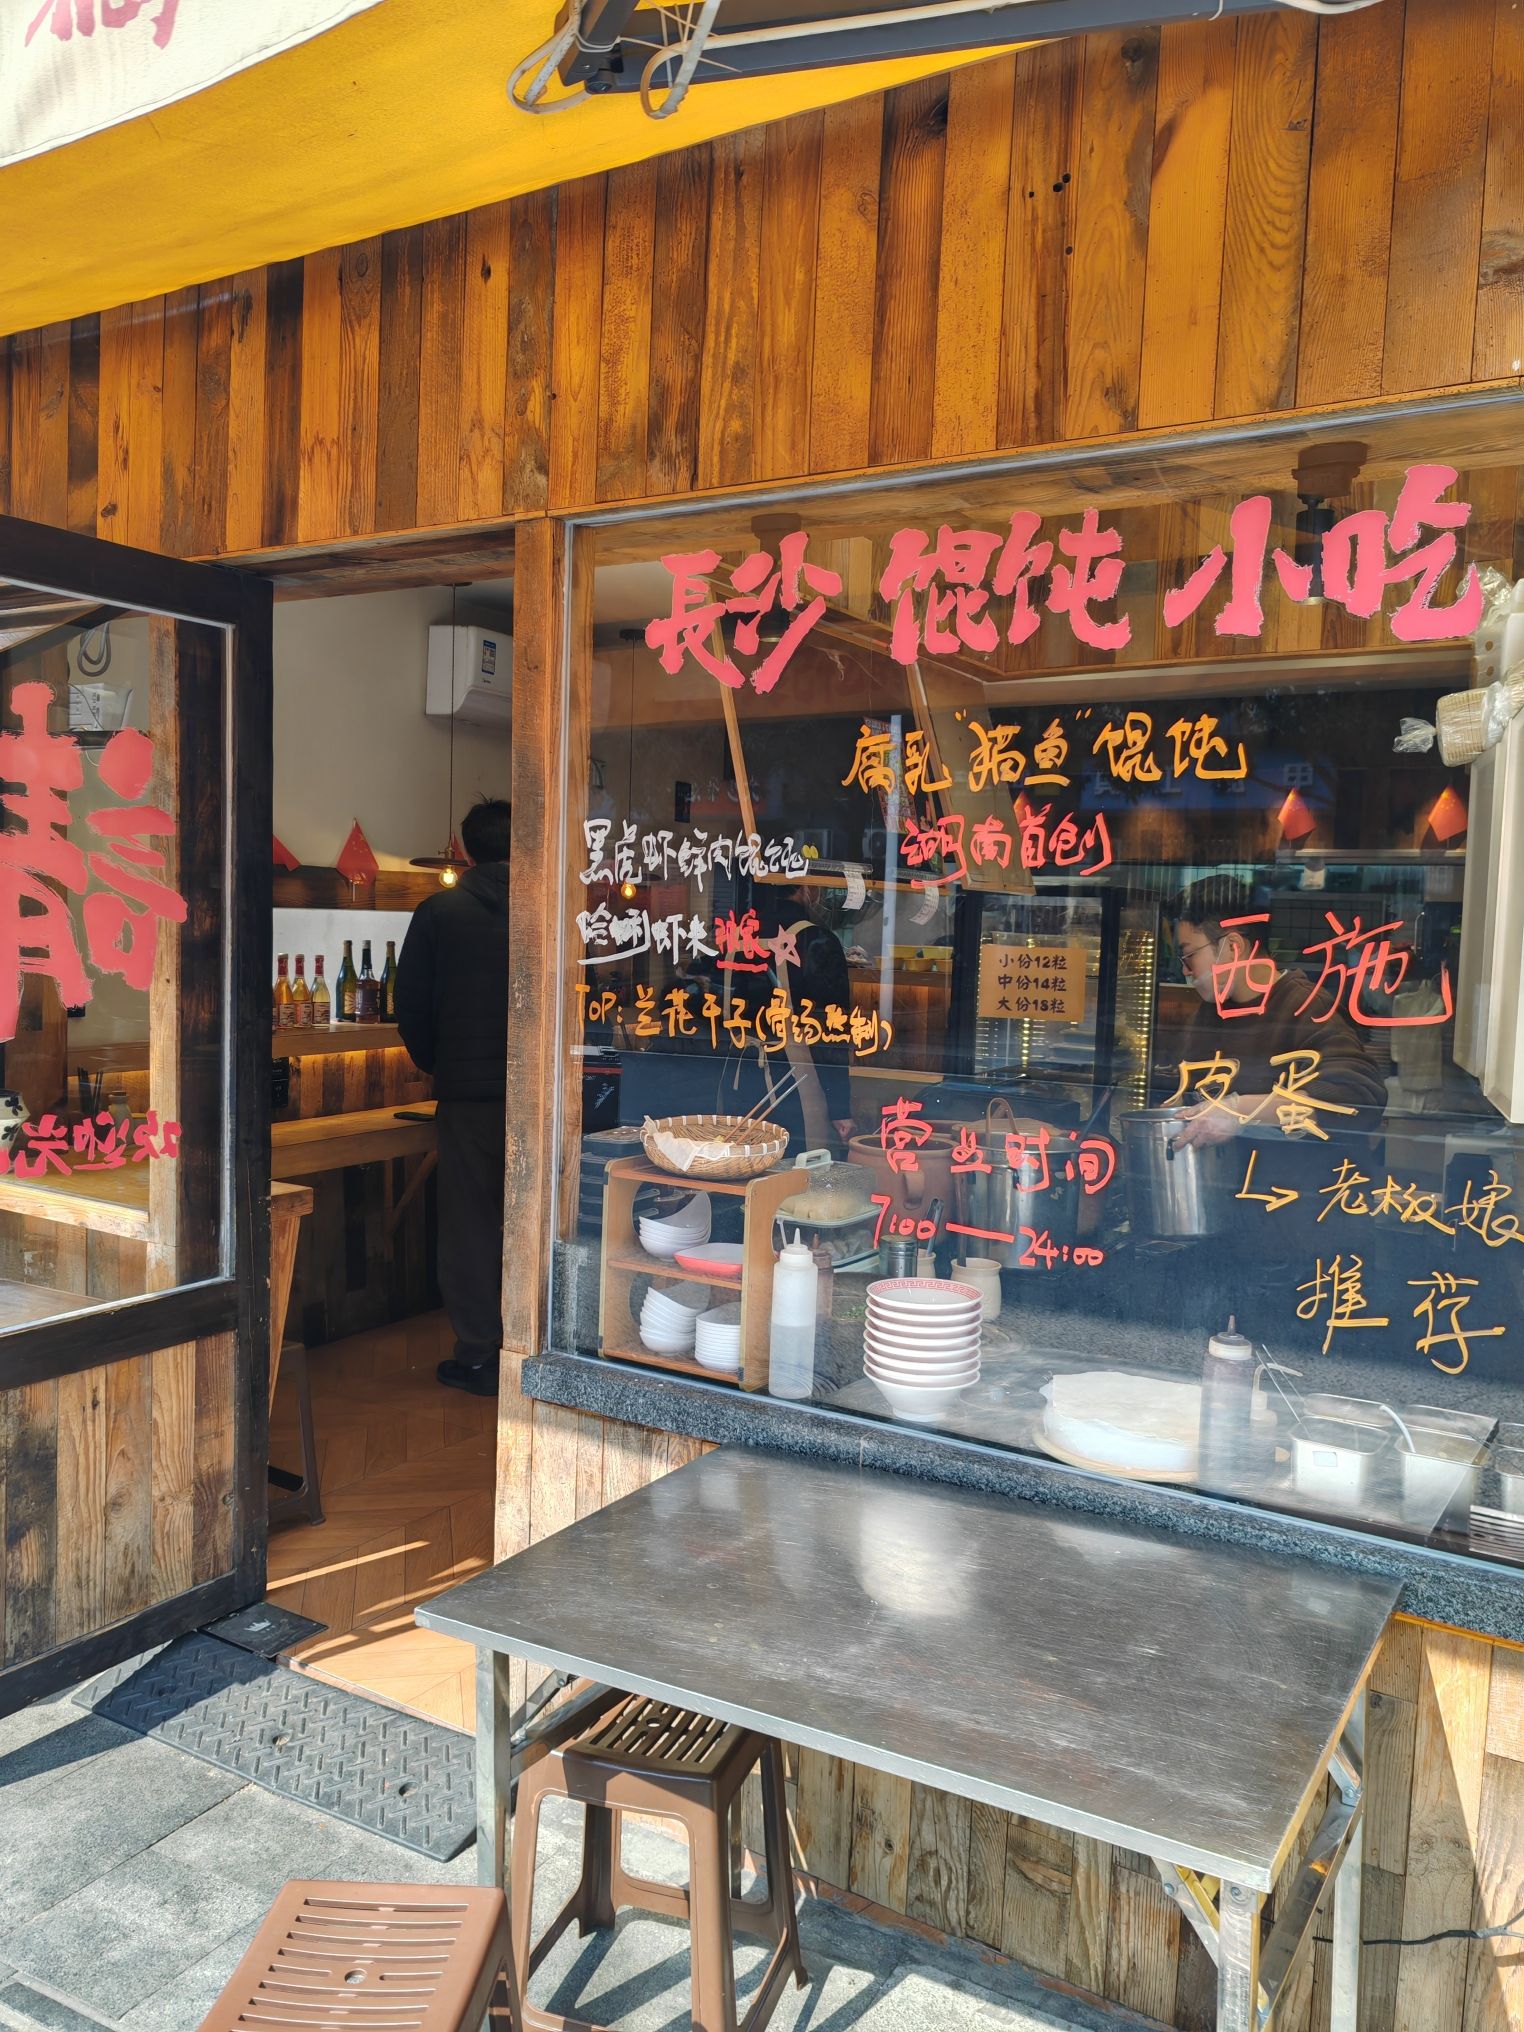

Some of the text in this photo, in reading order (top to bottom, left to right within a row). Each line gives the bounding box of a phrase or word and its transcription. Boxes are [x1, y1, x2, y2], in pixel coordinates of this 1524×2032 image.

[645, 464, 1485, 694] 長沙 馄饨 小吃
[900, 803, 1113, 889] 湖南首创
[996, 996, 1066, 1013] 大份18粒
[998, 974, 1067, 992] 中份14粒
[999, 954, 1068, 970] 小份12粒
[1212, 911, 1453, 1027] 西施
[1165, 1049, 1358, 1140] 皮蛋
[871, 1098, 1117, 1195] 营业时间
[1316, 1157, 1524, 1248] 老板娘
